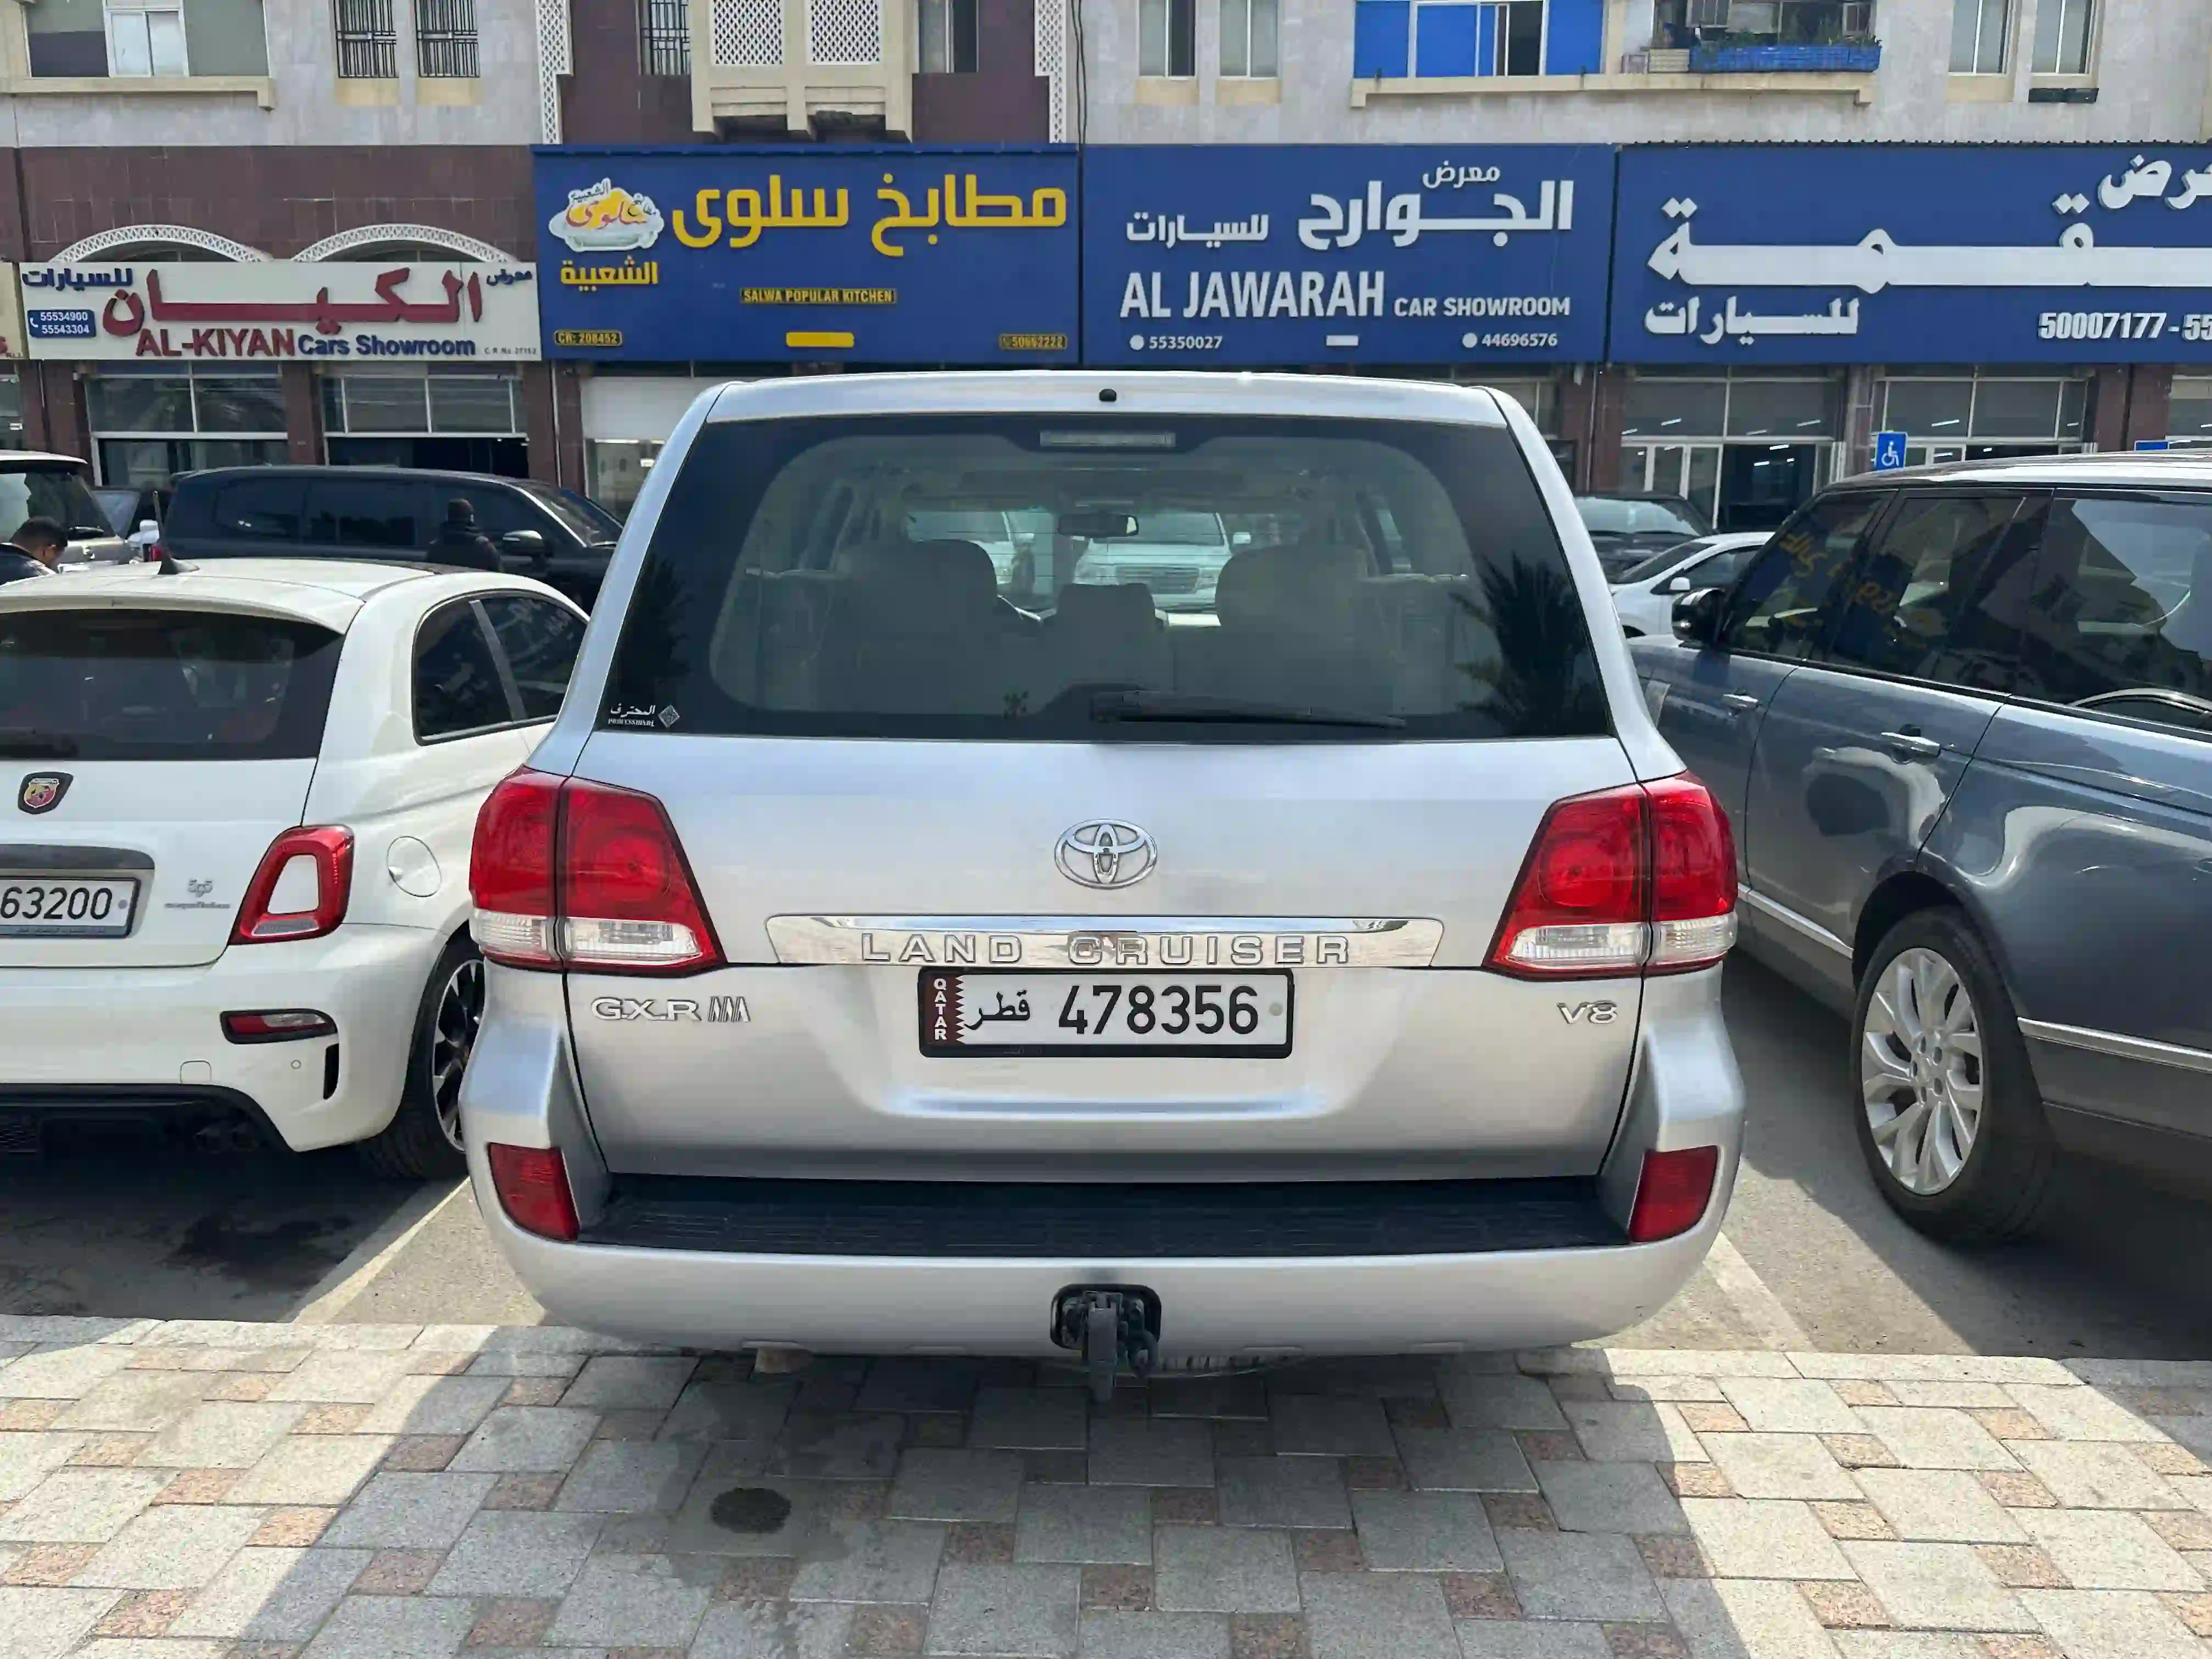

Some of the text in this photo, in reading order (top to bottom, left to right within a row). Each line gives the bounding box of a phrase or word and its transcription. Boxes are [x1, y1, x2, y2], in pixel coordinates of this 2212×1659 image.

[1423, 160, 1500, 188] معرض
[2097, 154, 2212, 210] رض
[673, 174, 1065, 256] مطابخ سلوى
[1126, 212, 1269, 248] للسيارات
[1298, 180, 1574, 250] الجوارح
[1647, 193, 2212, 293] قمة
[22, 268, 133, 291] للسيارات
[561, 255, 657, 292] الشعبية
[103, 267, 482, 337] الكيان
[744, 290, 892, 303] SALWA POPULAR KITCHEN
[1120, 271, 1571, 318] AL JAWARAH CAR SHOWROOM
[40, 312, 88, 321] 55534900
[42, 325, 90, 334] 55543304
[1644, 295, 1859, 345] للسيارات
[136, 328, 476, 357] AL-KIYAN Cars Showroom
[1149, 336, 1223, 349] 55350027
[1481, 333, 1558, 347] 44696576
[0, 887, 113, 920] 63200
[861, 932, 1350, 966] LAND CRUISER
[934, 977, 947, 1041] QATAR
[964, 990, 1031, 1030] قطر
[1058, 985, 1259, 1035] 478356
[1556, 1000, 1618, 1025] V8
